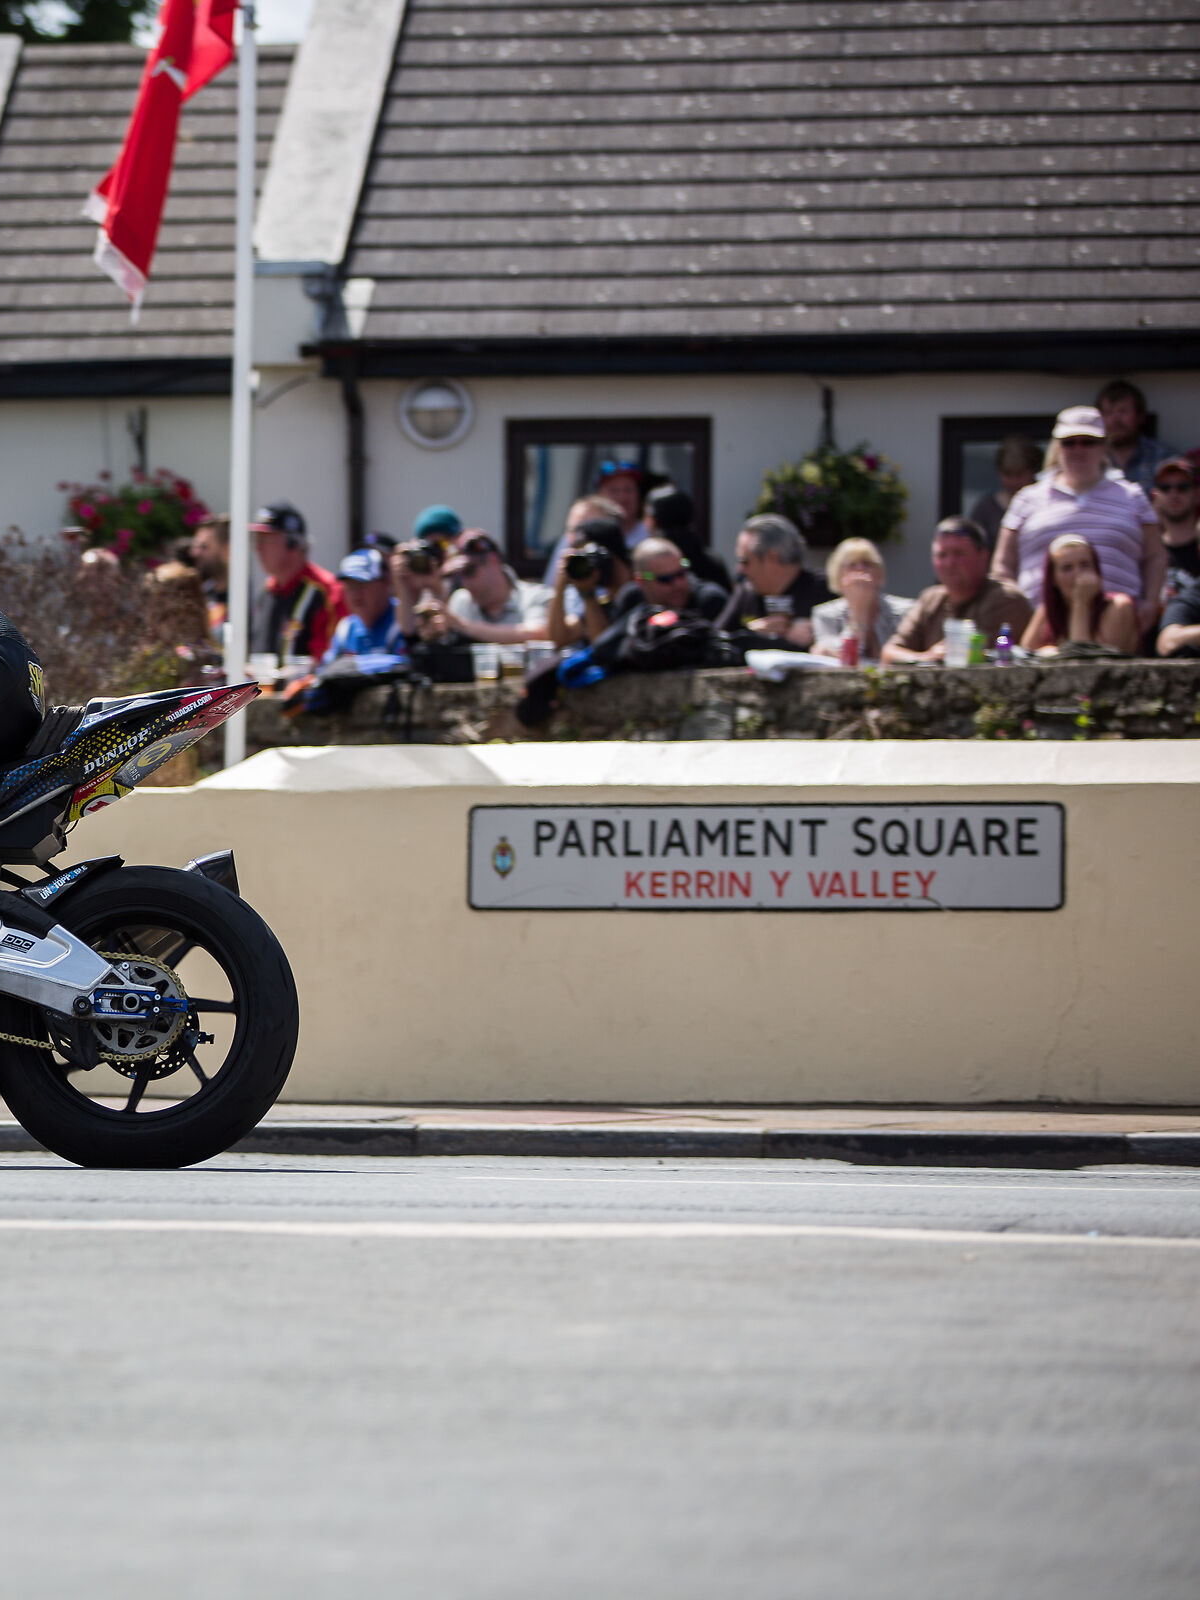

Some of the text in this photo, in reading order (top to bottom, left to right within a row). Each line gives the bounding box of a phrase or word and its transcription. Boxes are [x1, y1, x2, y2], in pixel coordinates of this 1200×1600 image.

[83, 728, 149, 775] DUNLOP
[533, 817, 1039, 857] PARLIAMENT SQUARE
[39, 864, 88, 900] UNSTOPPABLE
[624, 870, 937, 899] KERRIN Y VALLEY
[3, 935, 33, 949] DDC
